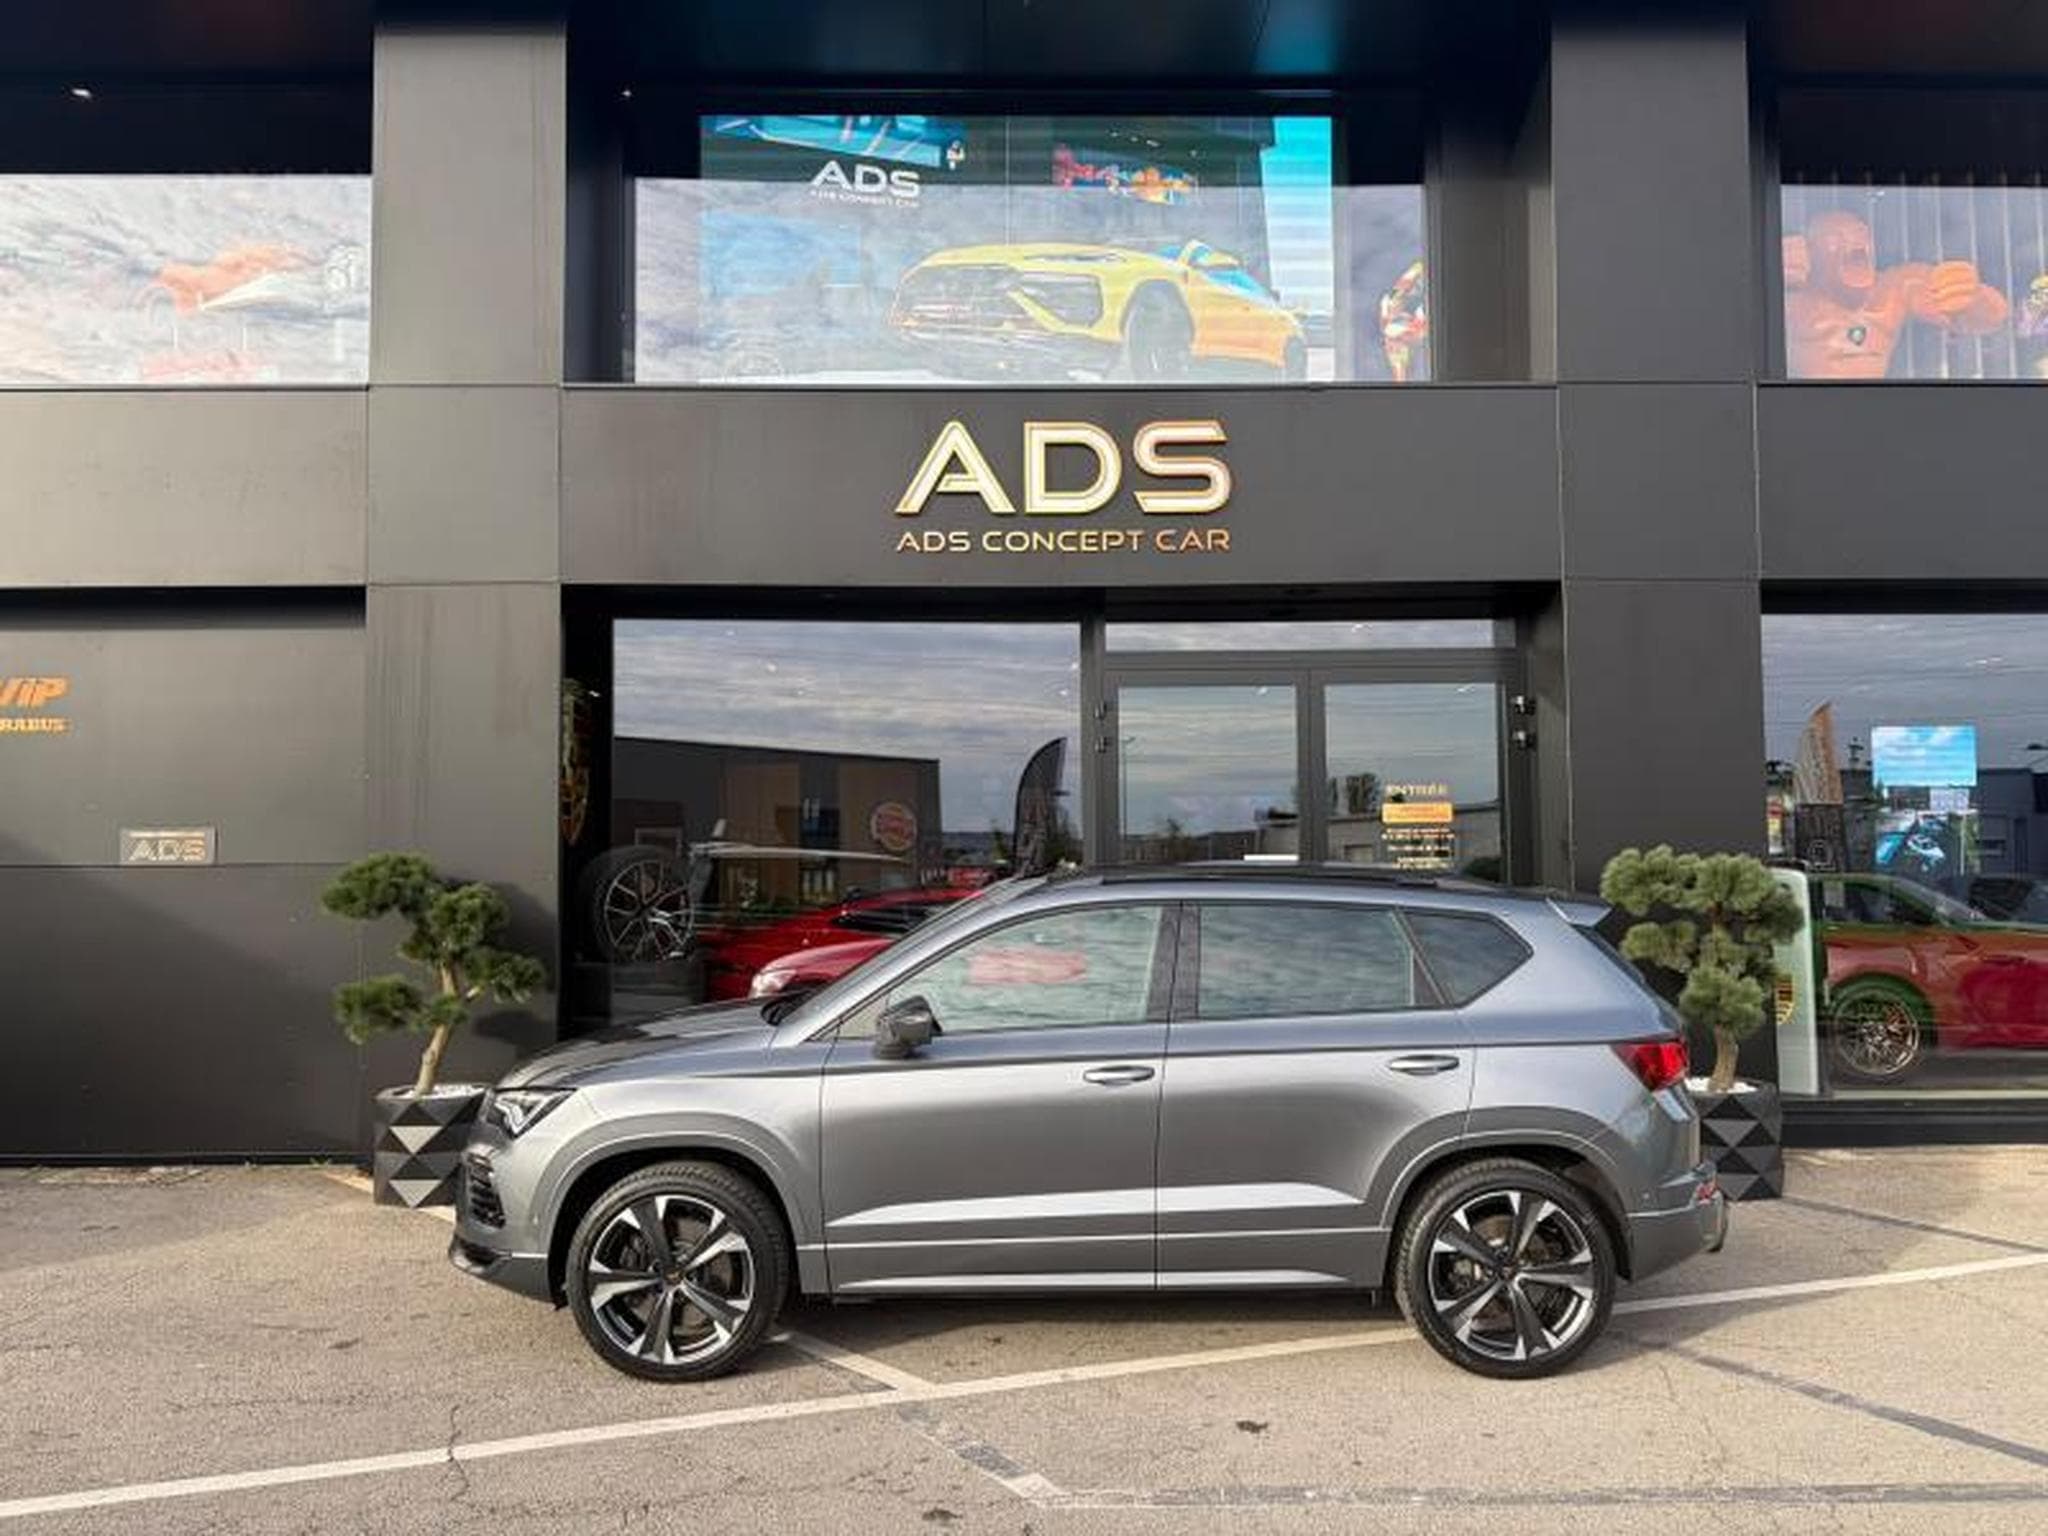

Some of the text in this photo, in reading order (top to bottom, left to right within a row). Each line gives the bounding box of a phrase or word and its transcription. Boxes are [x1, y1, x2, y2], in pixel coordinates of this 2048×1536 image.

[811, 160, 920, 198] ADS
[895, 420, 1231, 514] ADS
[897, 529, 1231, 551] ADS CONCEPT CAR
[128, 839, 205, 861] ADS
